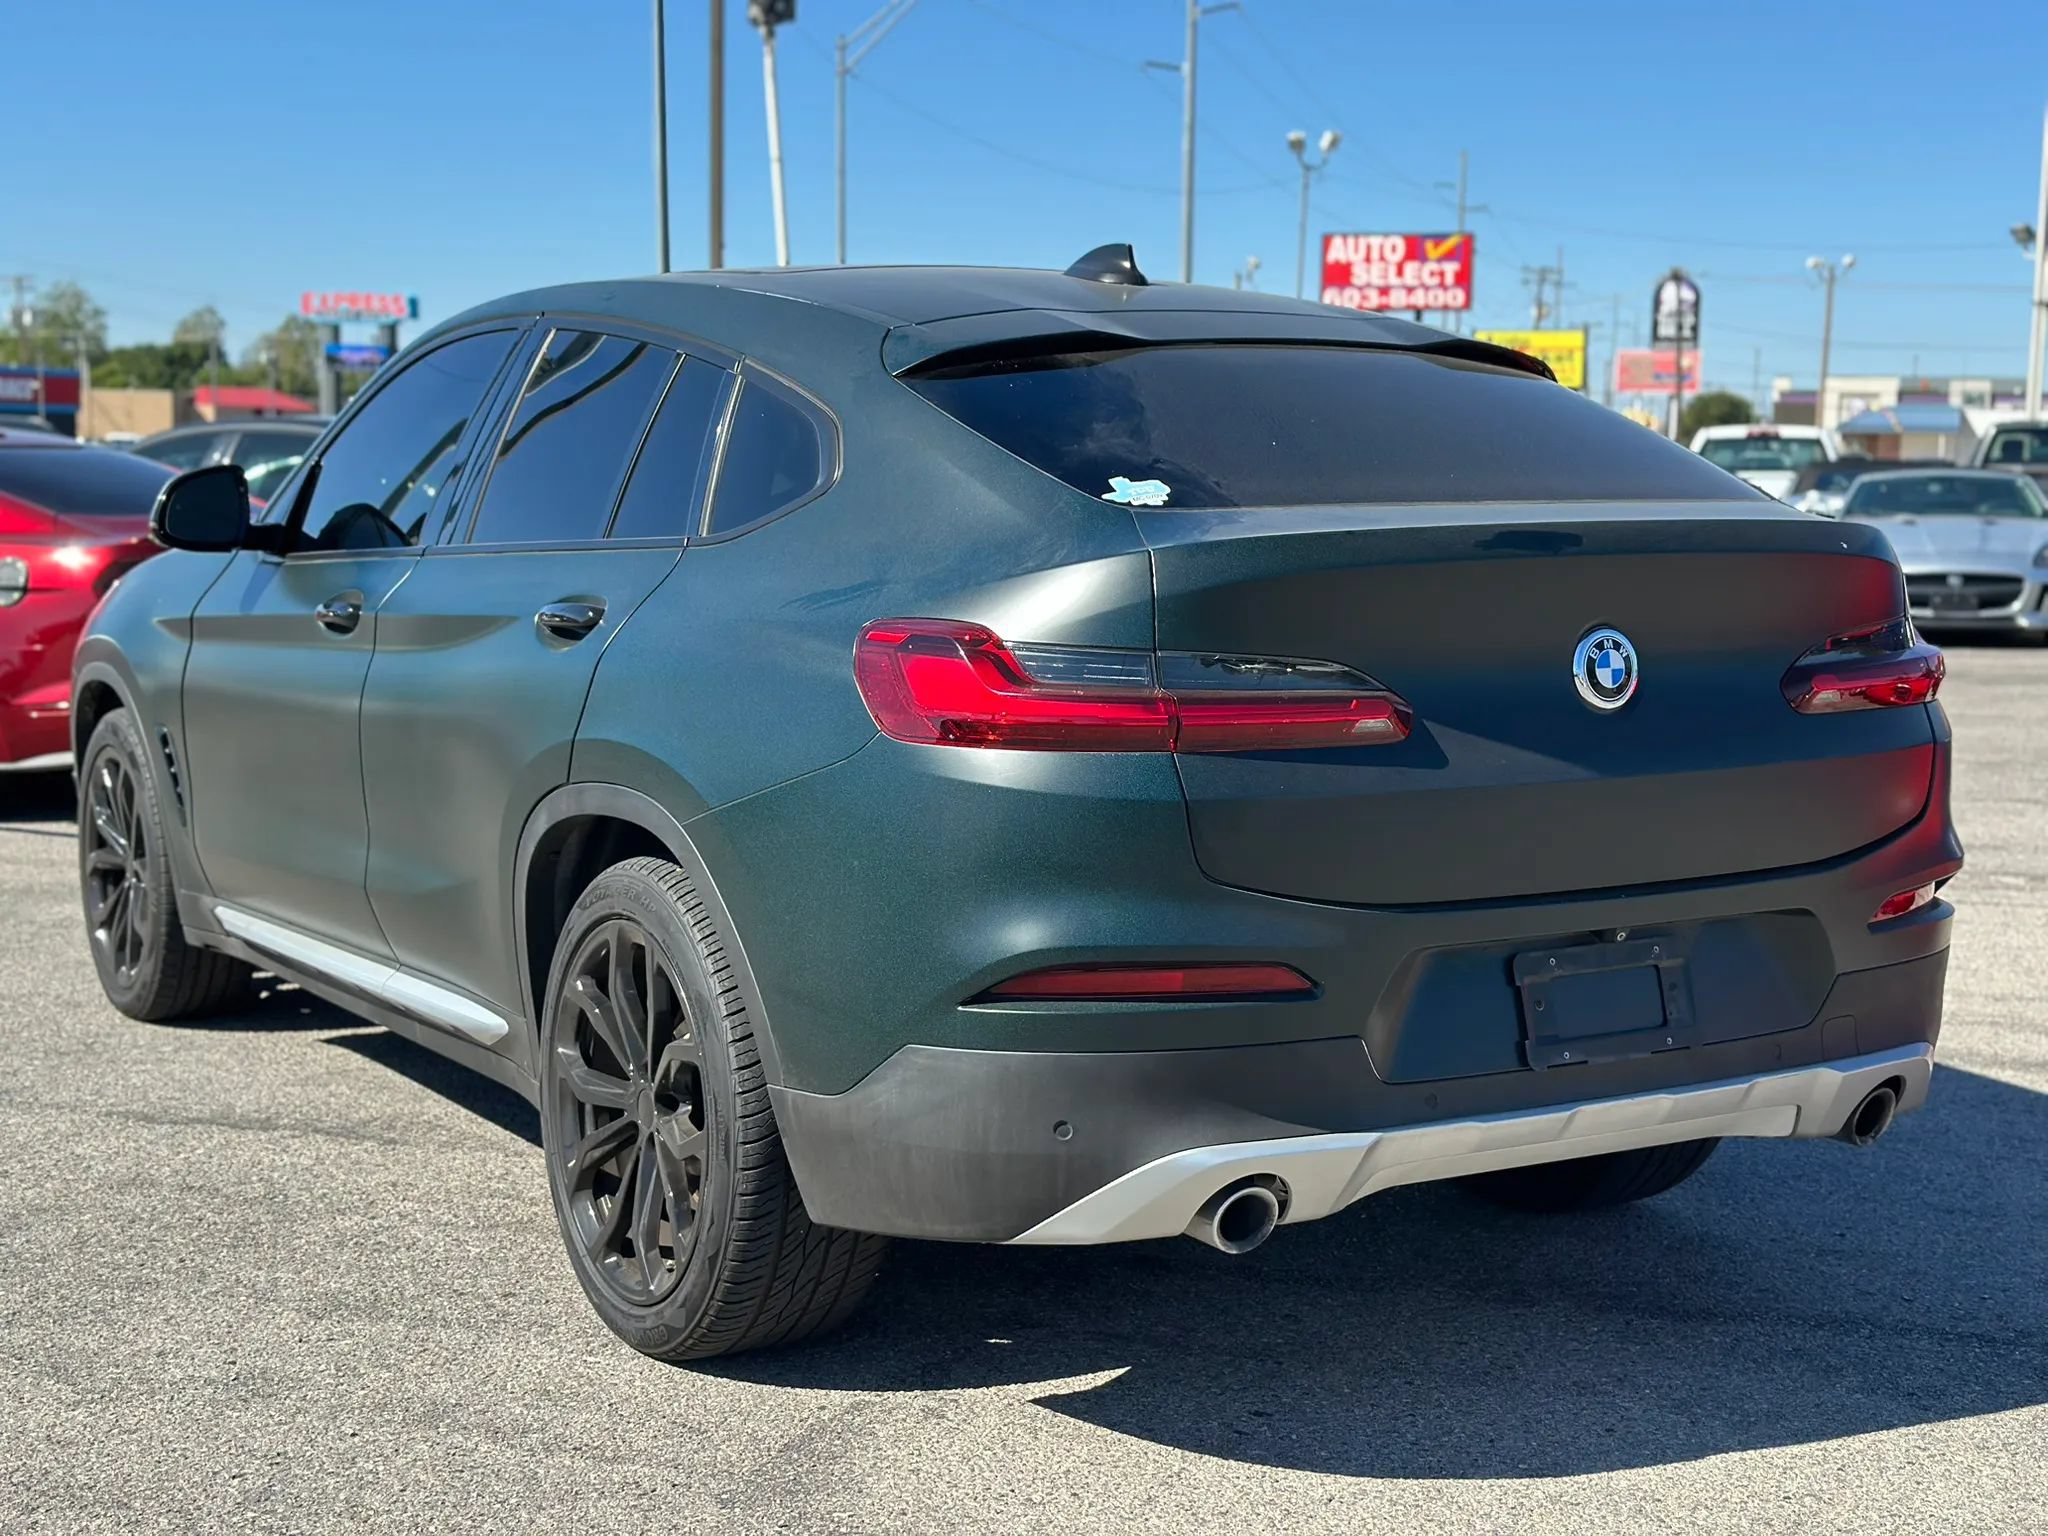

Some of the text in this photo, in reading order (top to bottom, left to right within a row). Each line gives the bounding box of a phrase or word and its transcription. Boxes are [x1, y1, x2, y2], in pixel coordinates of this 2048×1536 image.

[1326, 235, 1407, 264] AUTO
[1350, 261, 1461, 287] SELECT
[301, 290, 407, 318] EXPRESS
[1322, 286, 1467, 308] 603-8400
[1589, 638, 1628, 660] BMW
